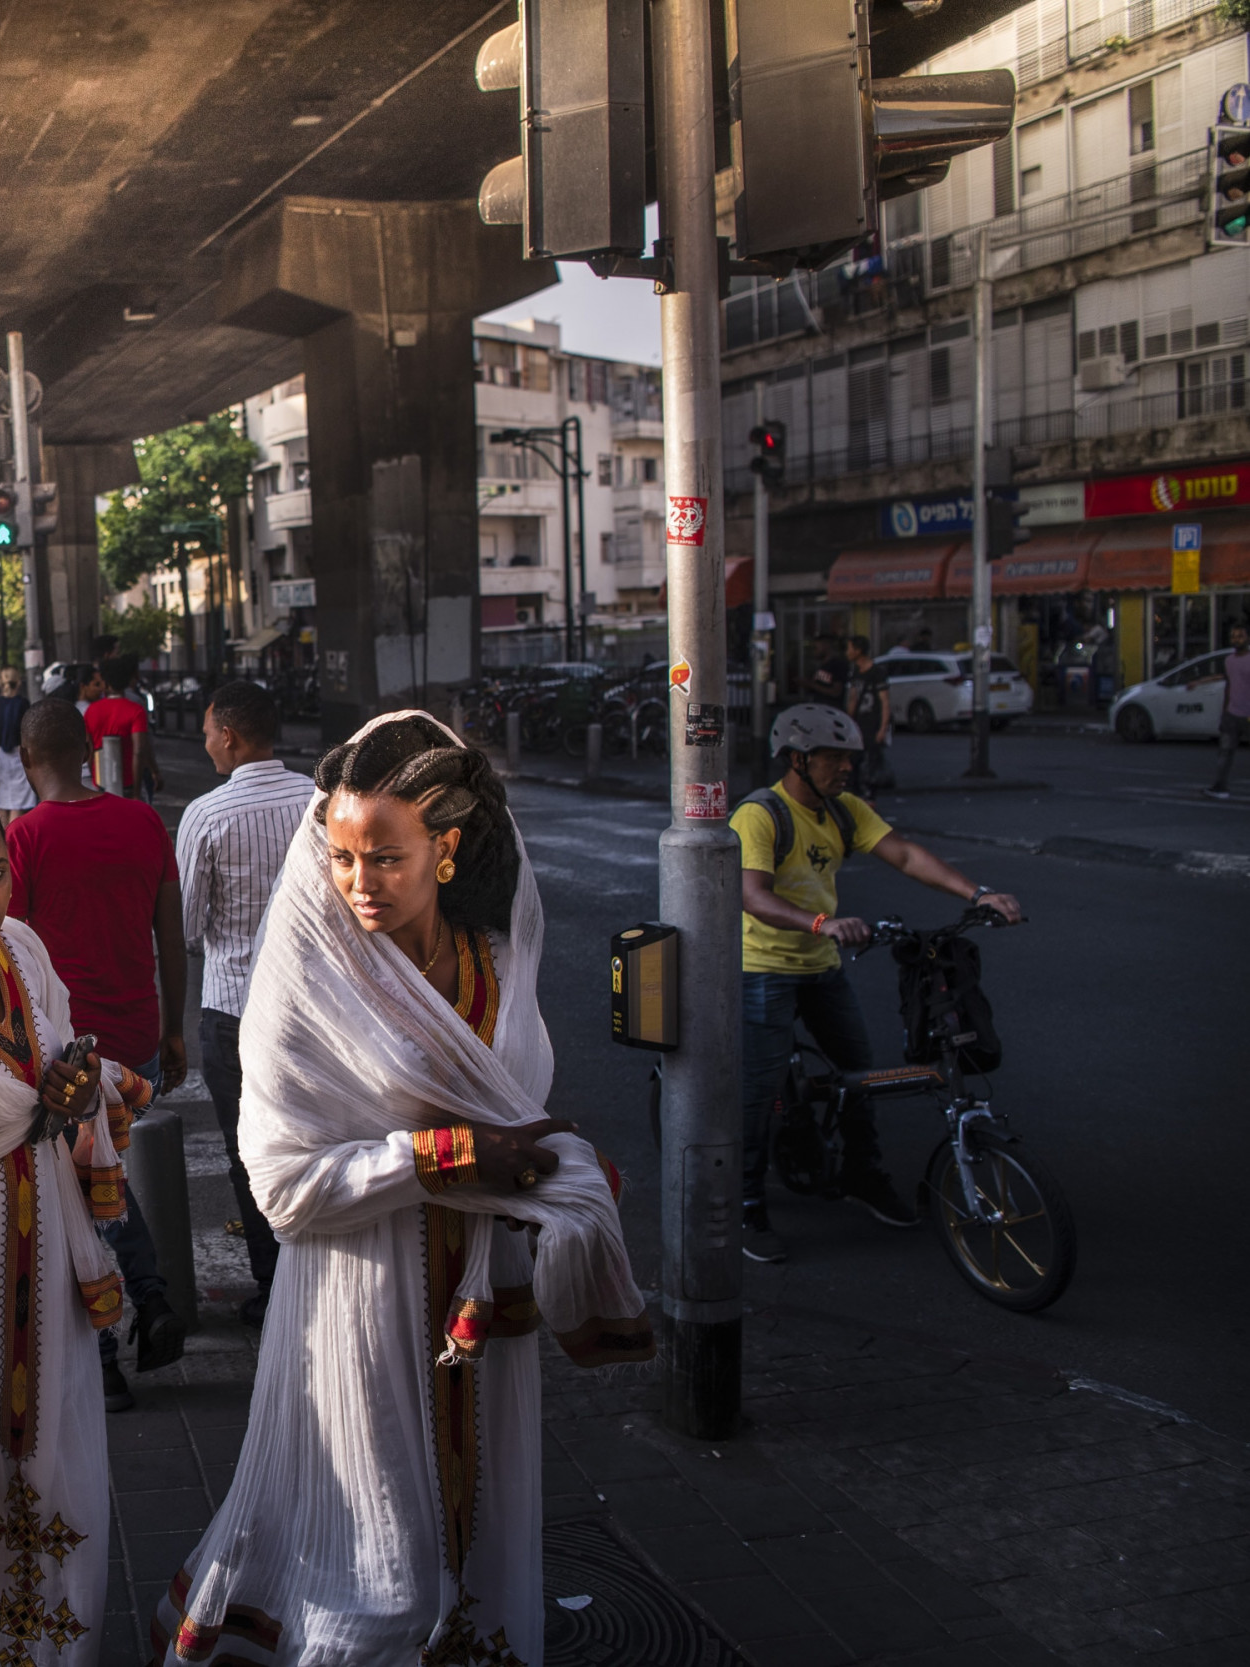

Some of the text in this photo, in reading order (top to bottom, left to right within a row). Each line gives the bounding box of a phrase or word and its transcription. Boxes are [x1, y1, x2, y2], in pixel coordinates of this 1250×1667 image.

[1184, 474, 1238, 501] טוטו
[919, 501, 957, 524] הפיס
[868, 1065, 930, 1079] MUSTANG
